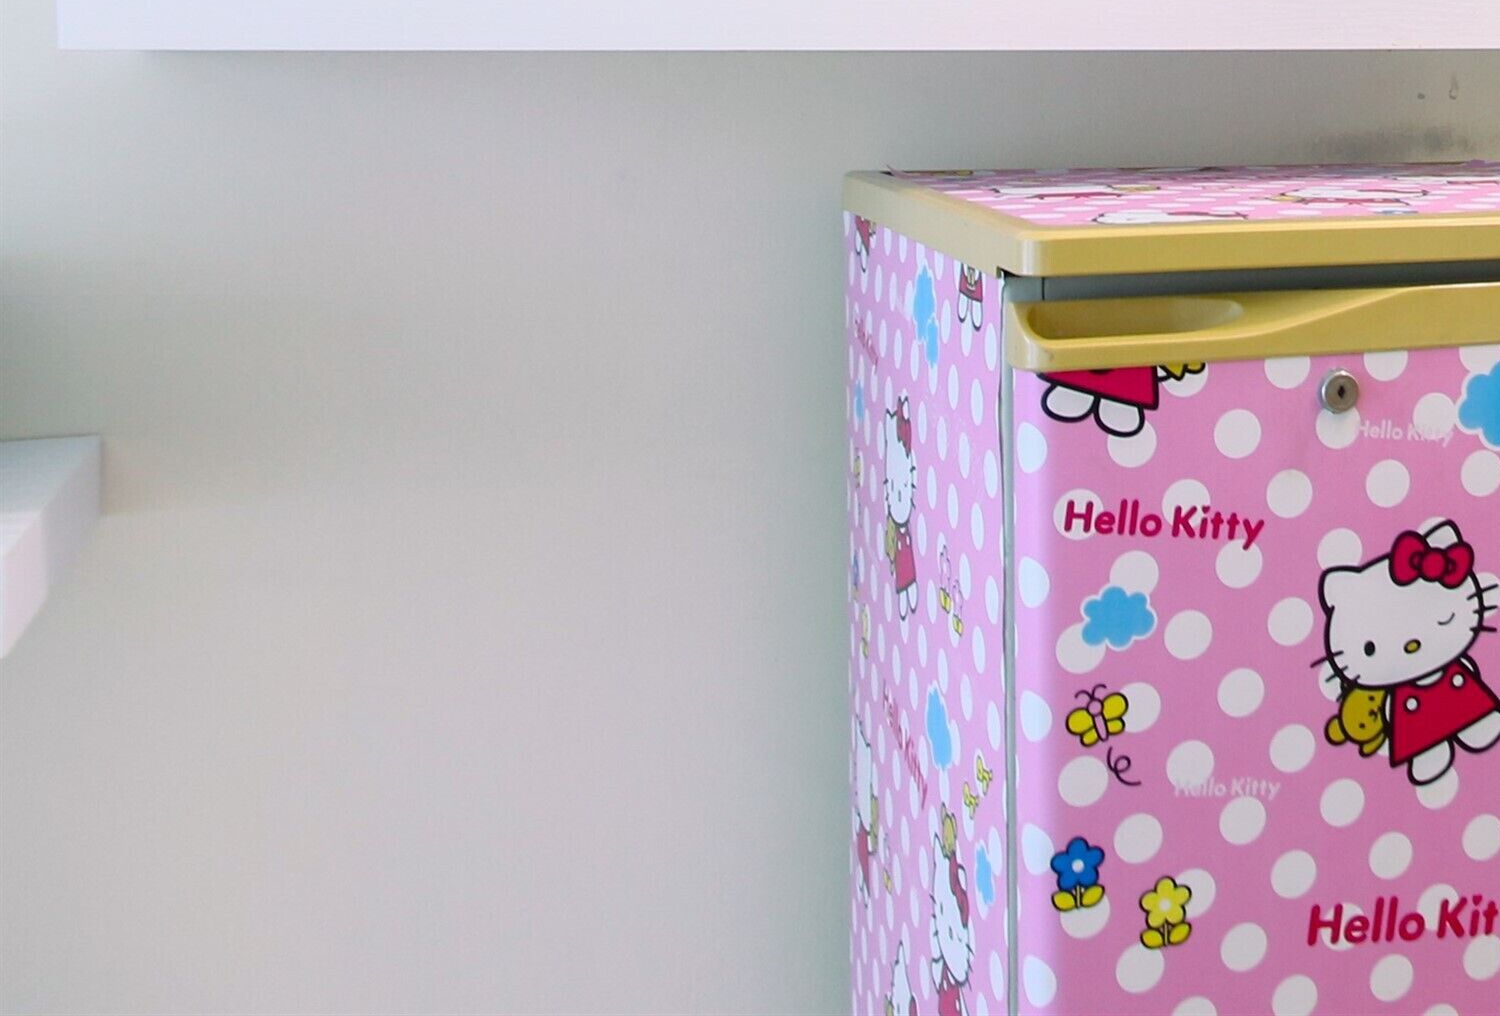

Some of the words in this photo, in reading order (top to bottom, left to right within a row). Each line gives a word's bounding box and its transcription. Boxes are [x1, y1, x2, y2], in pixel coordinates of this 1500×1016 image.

[1357, 418, 1403, 440] Hello
[1064, 499, 1162, 537] Hello
[1172, 505, 1265, 551] Kitty
[1307, 896, 1426, 946] Hello
